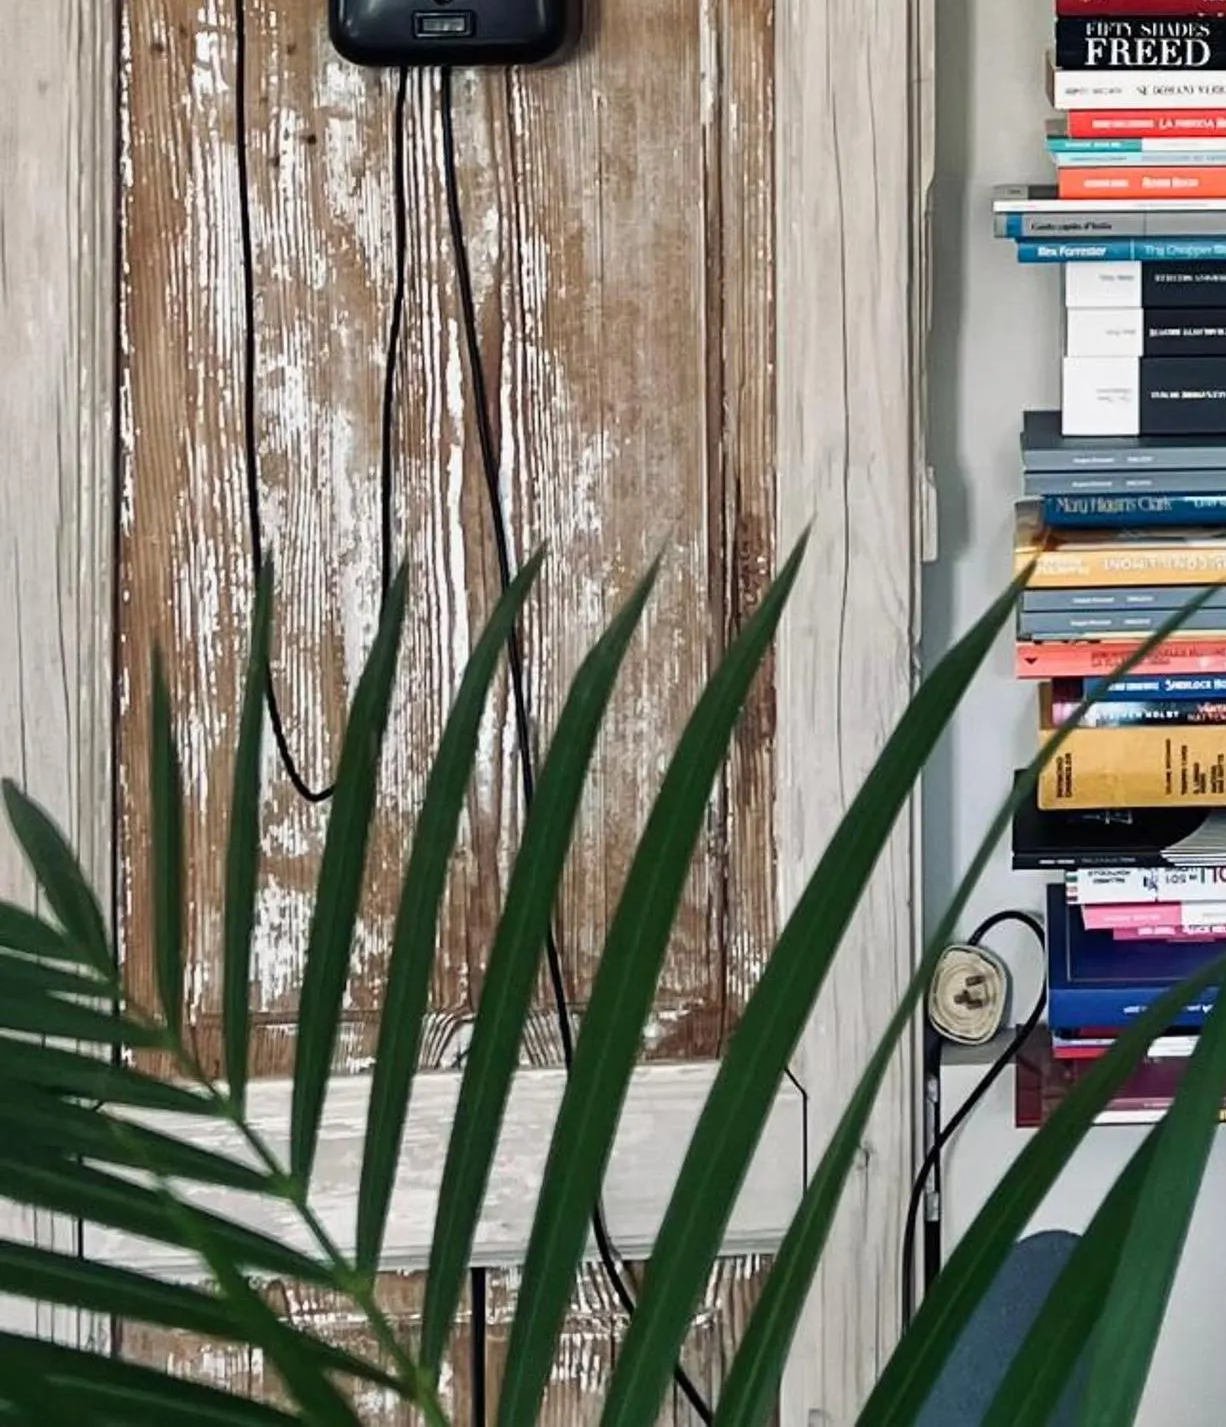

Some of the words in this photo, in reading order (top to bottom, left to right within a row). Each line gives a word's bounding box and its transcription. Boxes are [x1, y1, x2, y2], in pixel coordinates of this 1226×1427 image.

[1086, 22, 1133, 37] FIFTY
[1140, 22, 1211, 37] SHADES
[1084, 37, 1211, 66] FREED
[1165, 679, 1212, 691] SHERLOCK
